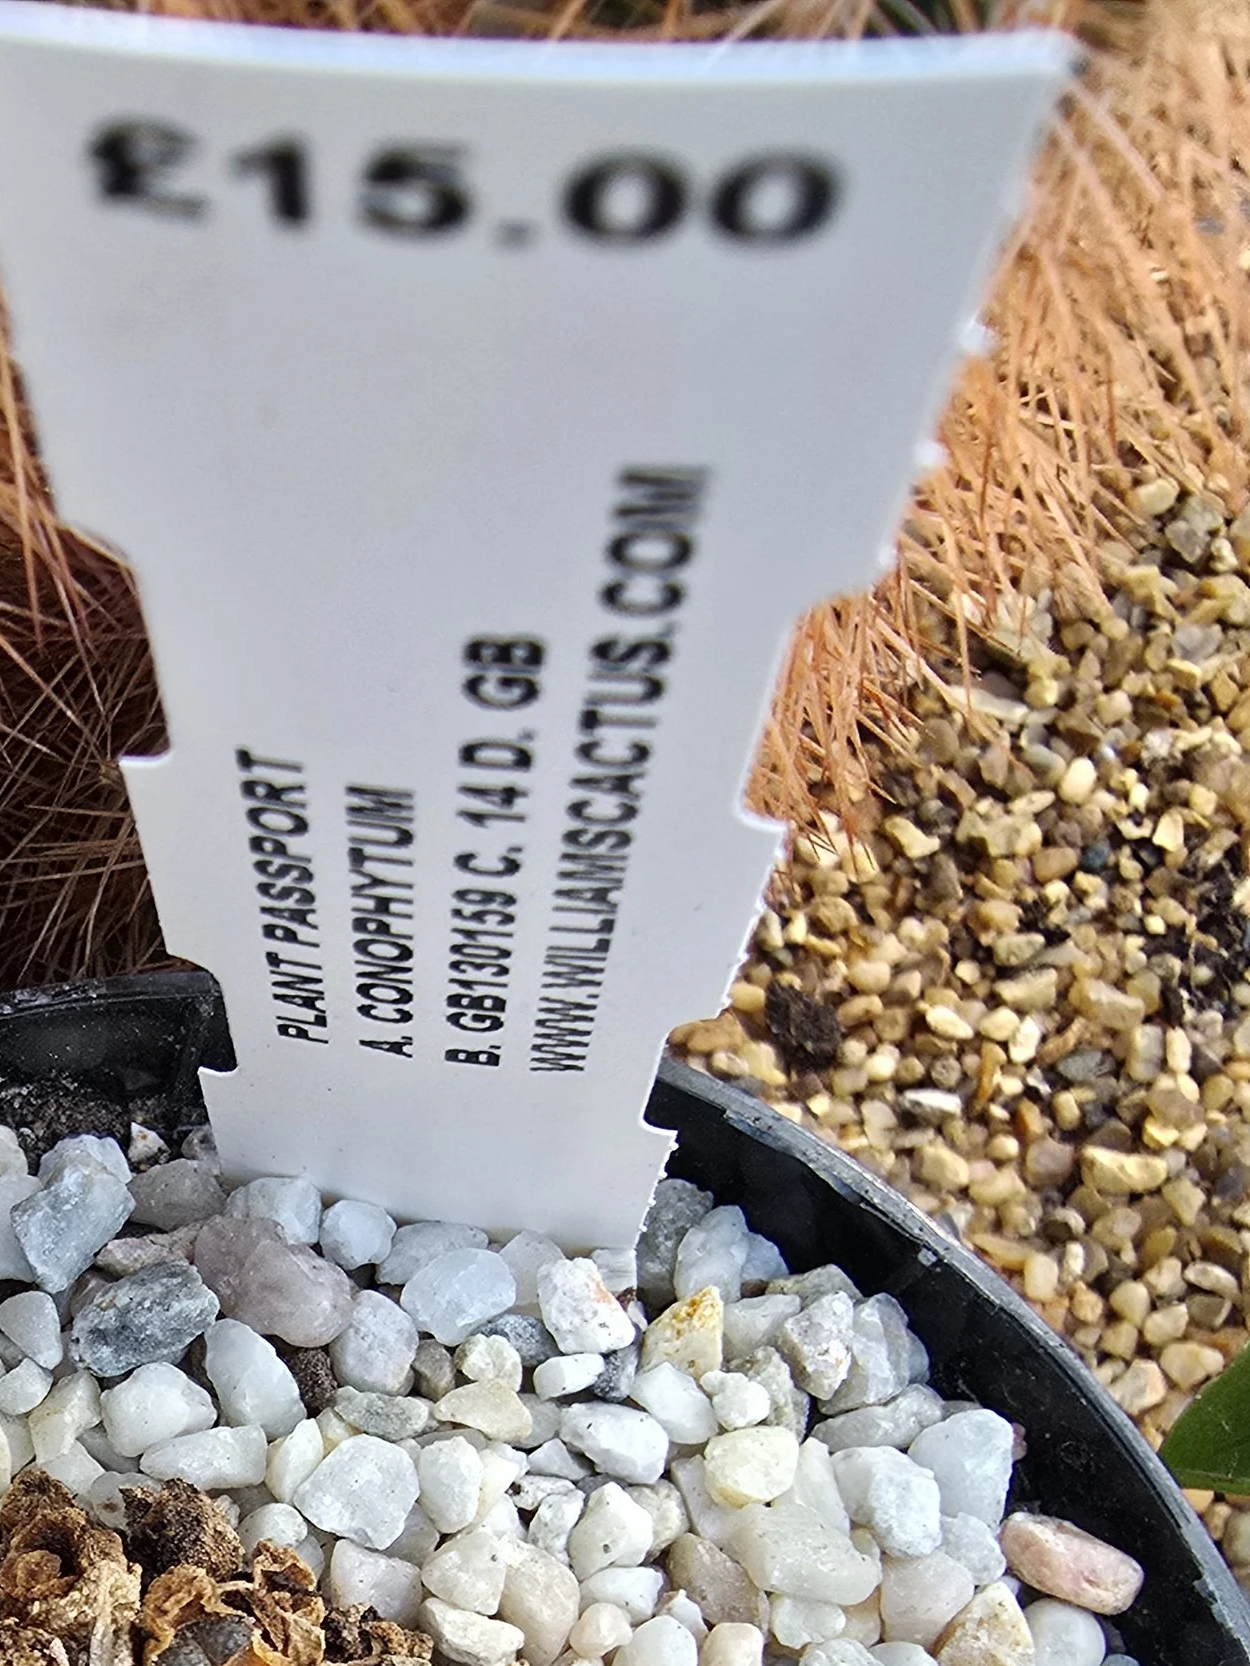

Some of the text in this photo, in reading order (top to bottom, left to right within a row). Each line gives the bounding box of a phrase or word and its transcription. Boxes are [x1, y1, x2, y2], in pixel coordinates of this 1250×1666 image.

[86, 118, 844, 248] £15.00
[236, 747, 329, 1043] PLANT PASSPORT
[444, 635, 546, 1067] B. GB130159 C. 14 D. GB
[530, 466, 710, 1073] WWW.WILLIAMSCACTUS.COM
[347, 786, 415, 1058] A. CONOPHYTUM
